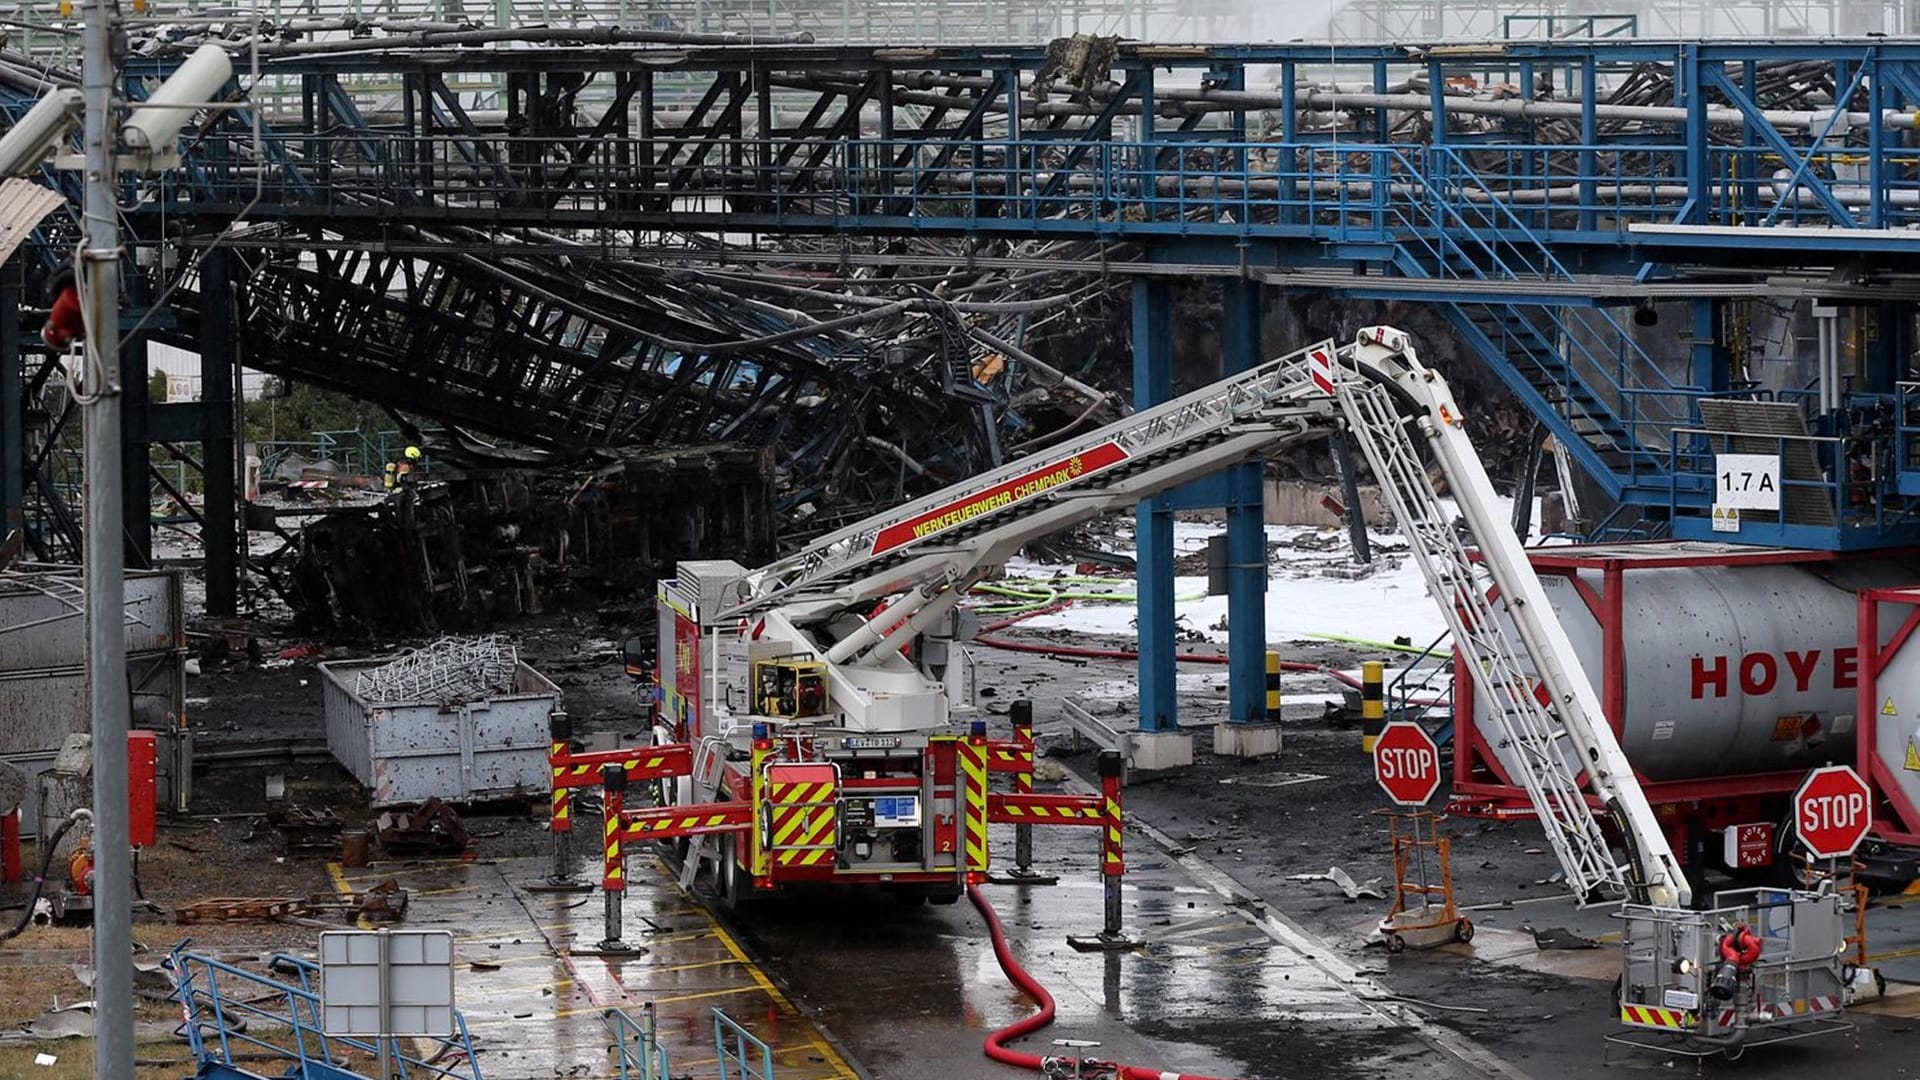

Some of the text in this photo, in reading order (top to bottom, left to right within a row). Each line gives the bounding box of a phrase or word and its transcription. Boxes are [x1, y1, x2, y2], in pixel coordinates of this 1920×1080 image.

[1722, 472, 1774, 492] 1.7 A
[913, 468, 1071, 538] WERKFEUERWEHR CHEMPARK
[1691, 646, 1887, 699] HOYE
[1381, 748, 1432, 780] STOP
[1804, 793, 1863, 832] STOP
[942, 840, 950, 852] 2
[1742, 849, 1767, 864] GROUP
